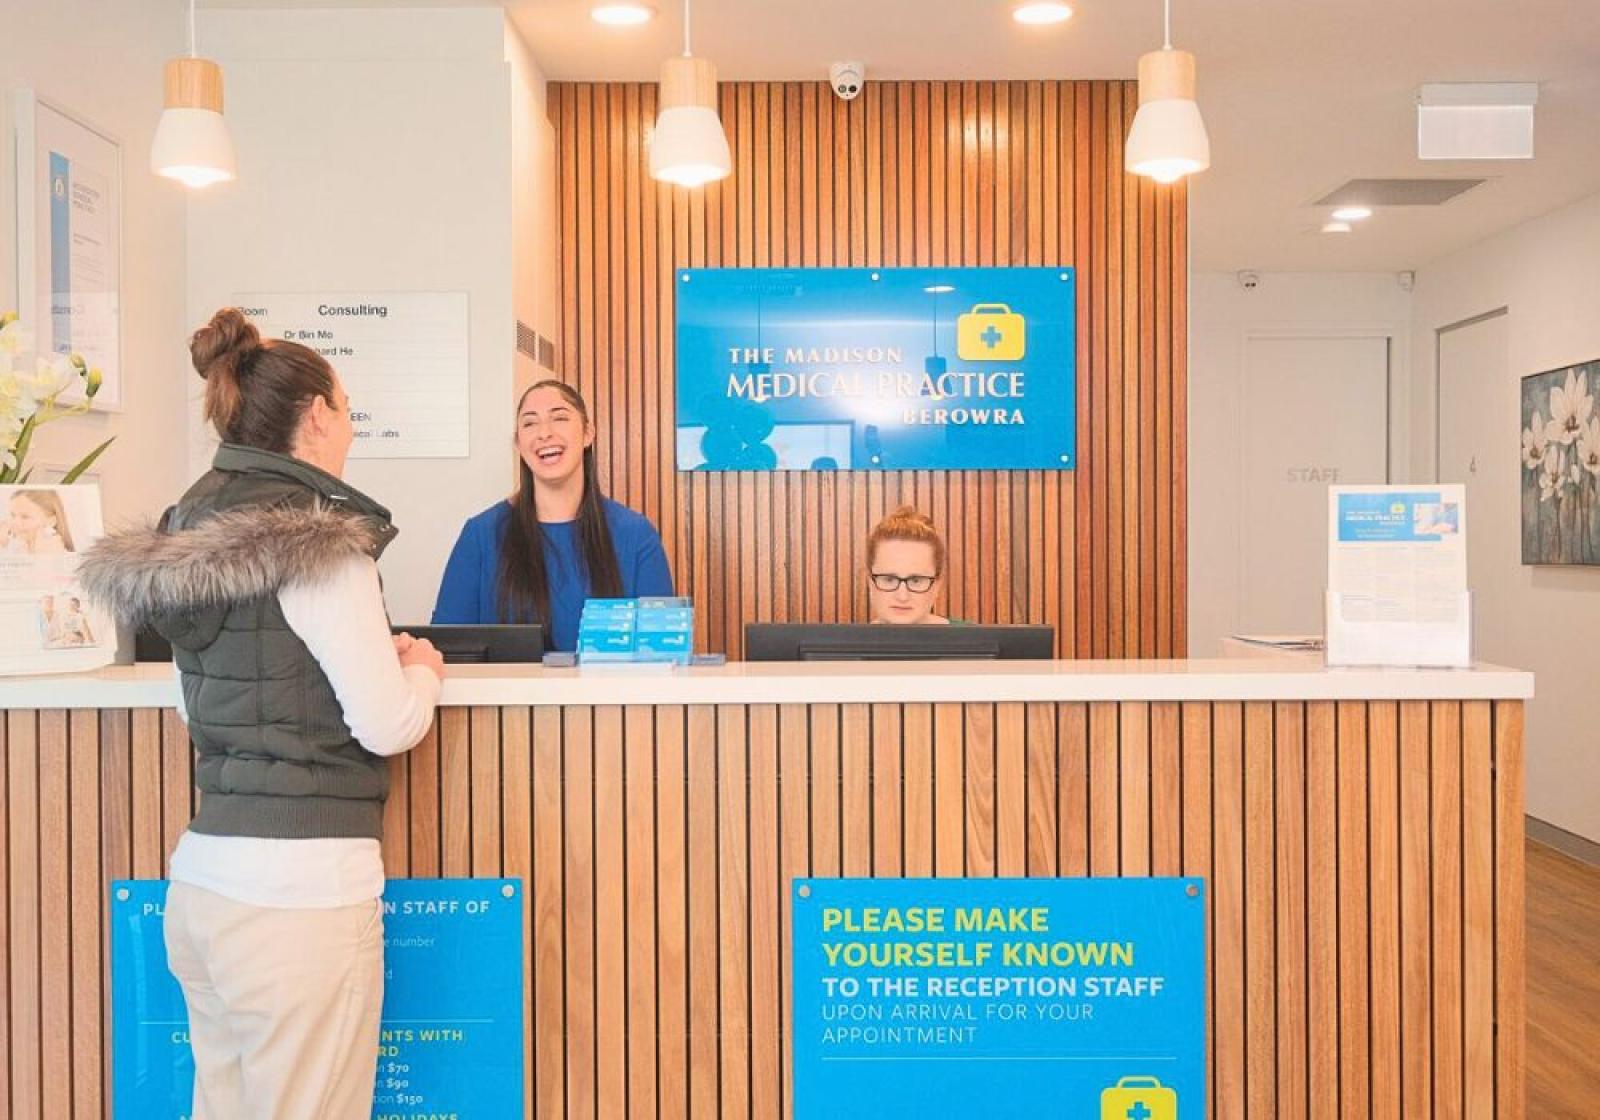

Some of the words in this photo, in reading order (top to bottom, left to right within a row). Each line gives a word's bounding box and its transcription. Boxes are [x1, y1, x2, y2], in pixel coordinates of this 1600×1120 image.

[318, 303, 388, 317] Consulting
[284, 330, 296, 339] Dr
[299, 330, 315, 339] Bin
[729, 348, 774, 364] THE
[784, 347, 901, 363] MADISON
[727, 372, 862, 398] MEDICAL
[874, 371, 1025, 398] PRACTICE
[903, 408, 1025, 425] BEROWRA
[403, 901, 459, 914] STAFF
[465, 900, 490, 914] OF
[823, 908, 945, 932] PLEASE
[954, 908, 1048, 932] MAKE
[393, 935, 435, 947] number
[822, 943, 993, 967] YOURSELF
[1002, 943, 1134, 967] KNOWN
[822, 977, 860, 997] TO
[867, 977, 920, 997] THE
[927, 977, 1077, 997] RECEPTION
[1084, 977, 1164, 997] STAFF
[822, 1004, 883, 1020] UPON
[891, 1004, 977, 1020] ARRIVAL
[986, 1004, 1027, 1020] FOR
[1035, 1004, 1094, 1020] YOUR
[420, 1029, 463, 1041] WITH
[822, 1026, 977, 1044] APPOINTMENT
[388, 1062, 410, 1078] $70
[396, 1094, 424, 1106] $150
